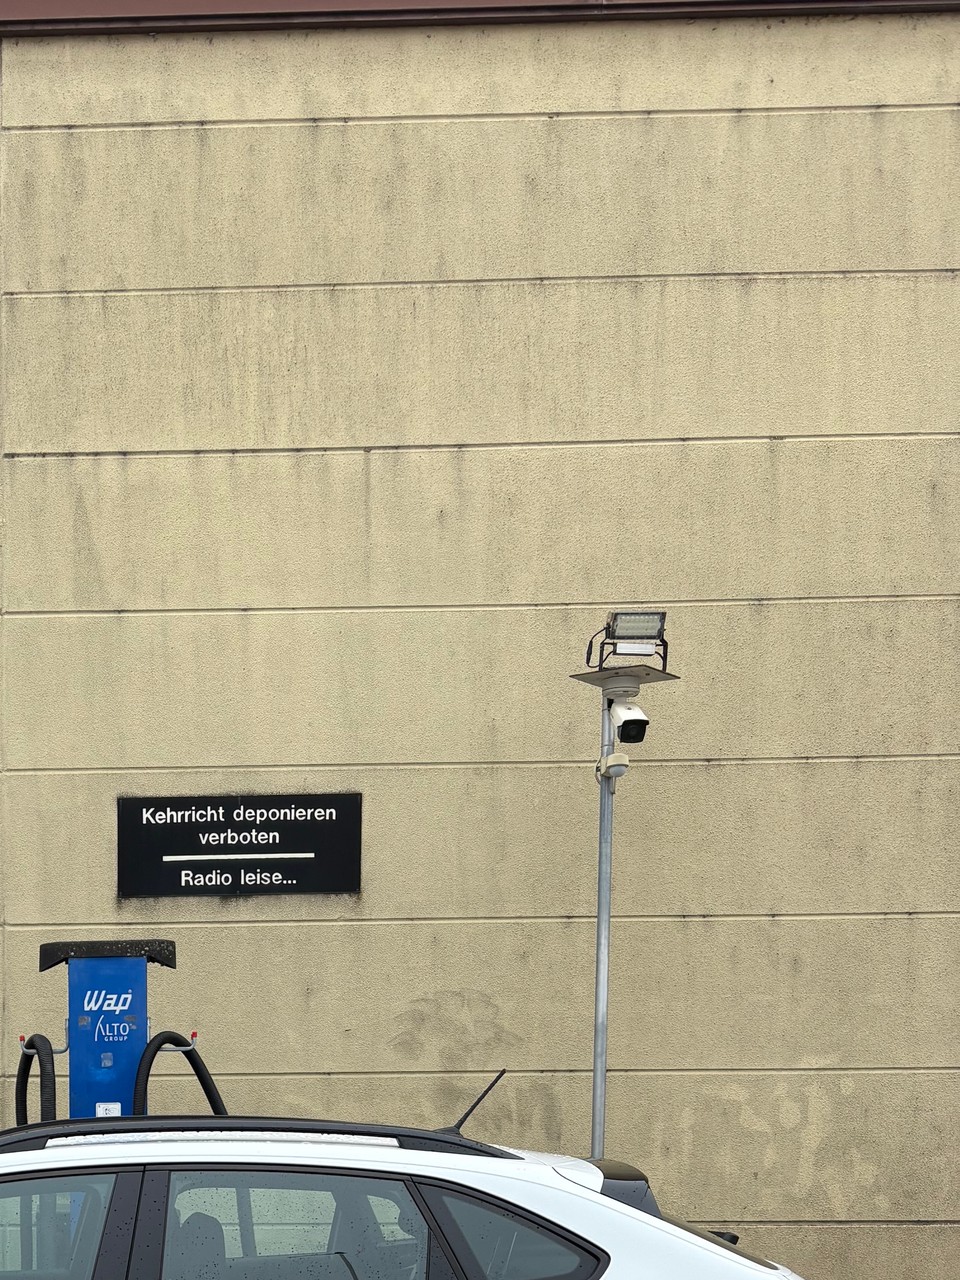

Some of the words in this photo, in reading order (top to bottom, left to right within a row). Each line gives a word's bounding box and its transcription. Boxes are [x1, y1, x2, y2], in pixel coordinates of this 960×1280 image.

[142, 806, 225, 824] Kehrricht
[233, 805, 337, 824] deponieren
[199, 829, 280, 845] verboten
[181, 870, 232, 886] Radio
[240, 869, 296, 885] leise...
[83, 990, 132, 1015] Wap
